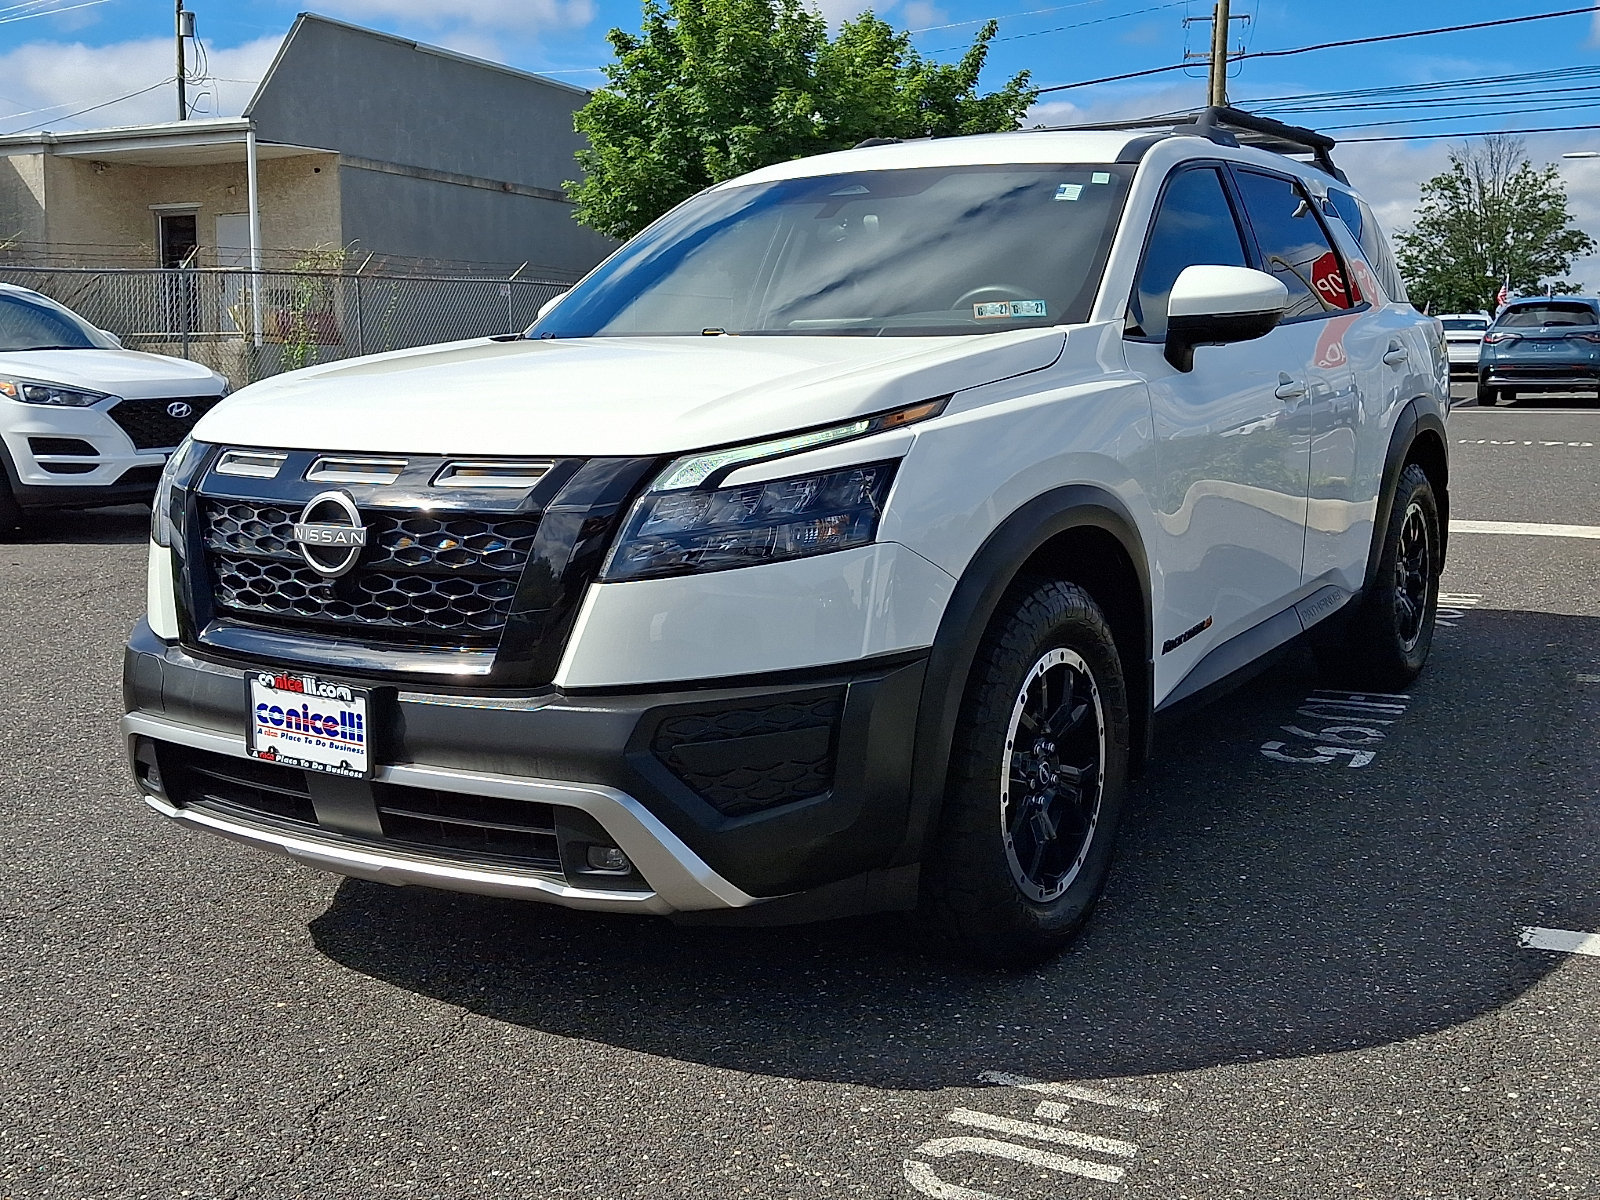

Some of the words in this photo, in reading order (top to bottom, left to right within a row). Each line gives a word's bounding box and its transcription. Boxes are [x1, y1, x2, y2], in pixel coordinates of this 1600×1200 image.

[295, 527, 364, 544] NISSAN
[258, 673, 352, 701] conicelli.com
[256, 703, 364, 742] conicelli
[280, 732, 302, 743] Place
[304, 736, 313, 745] To
[315, 739, 327, 748] Do
[329, 741, 365, 755] Business
[252, 750, 259, 758] A
[276, 754, 298, 766] Place
[300, 759, 310, 767] To
[312, 761, 324, 771] Do
[326, 765, 363, 779] Business
